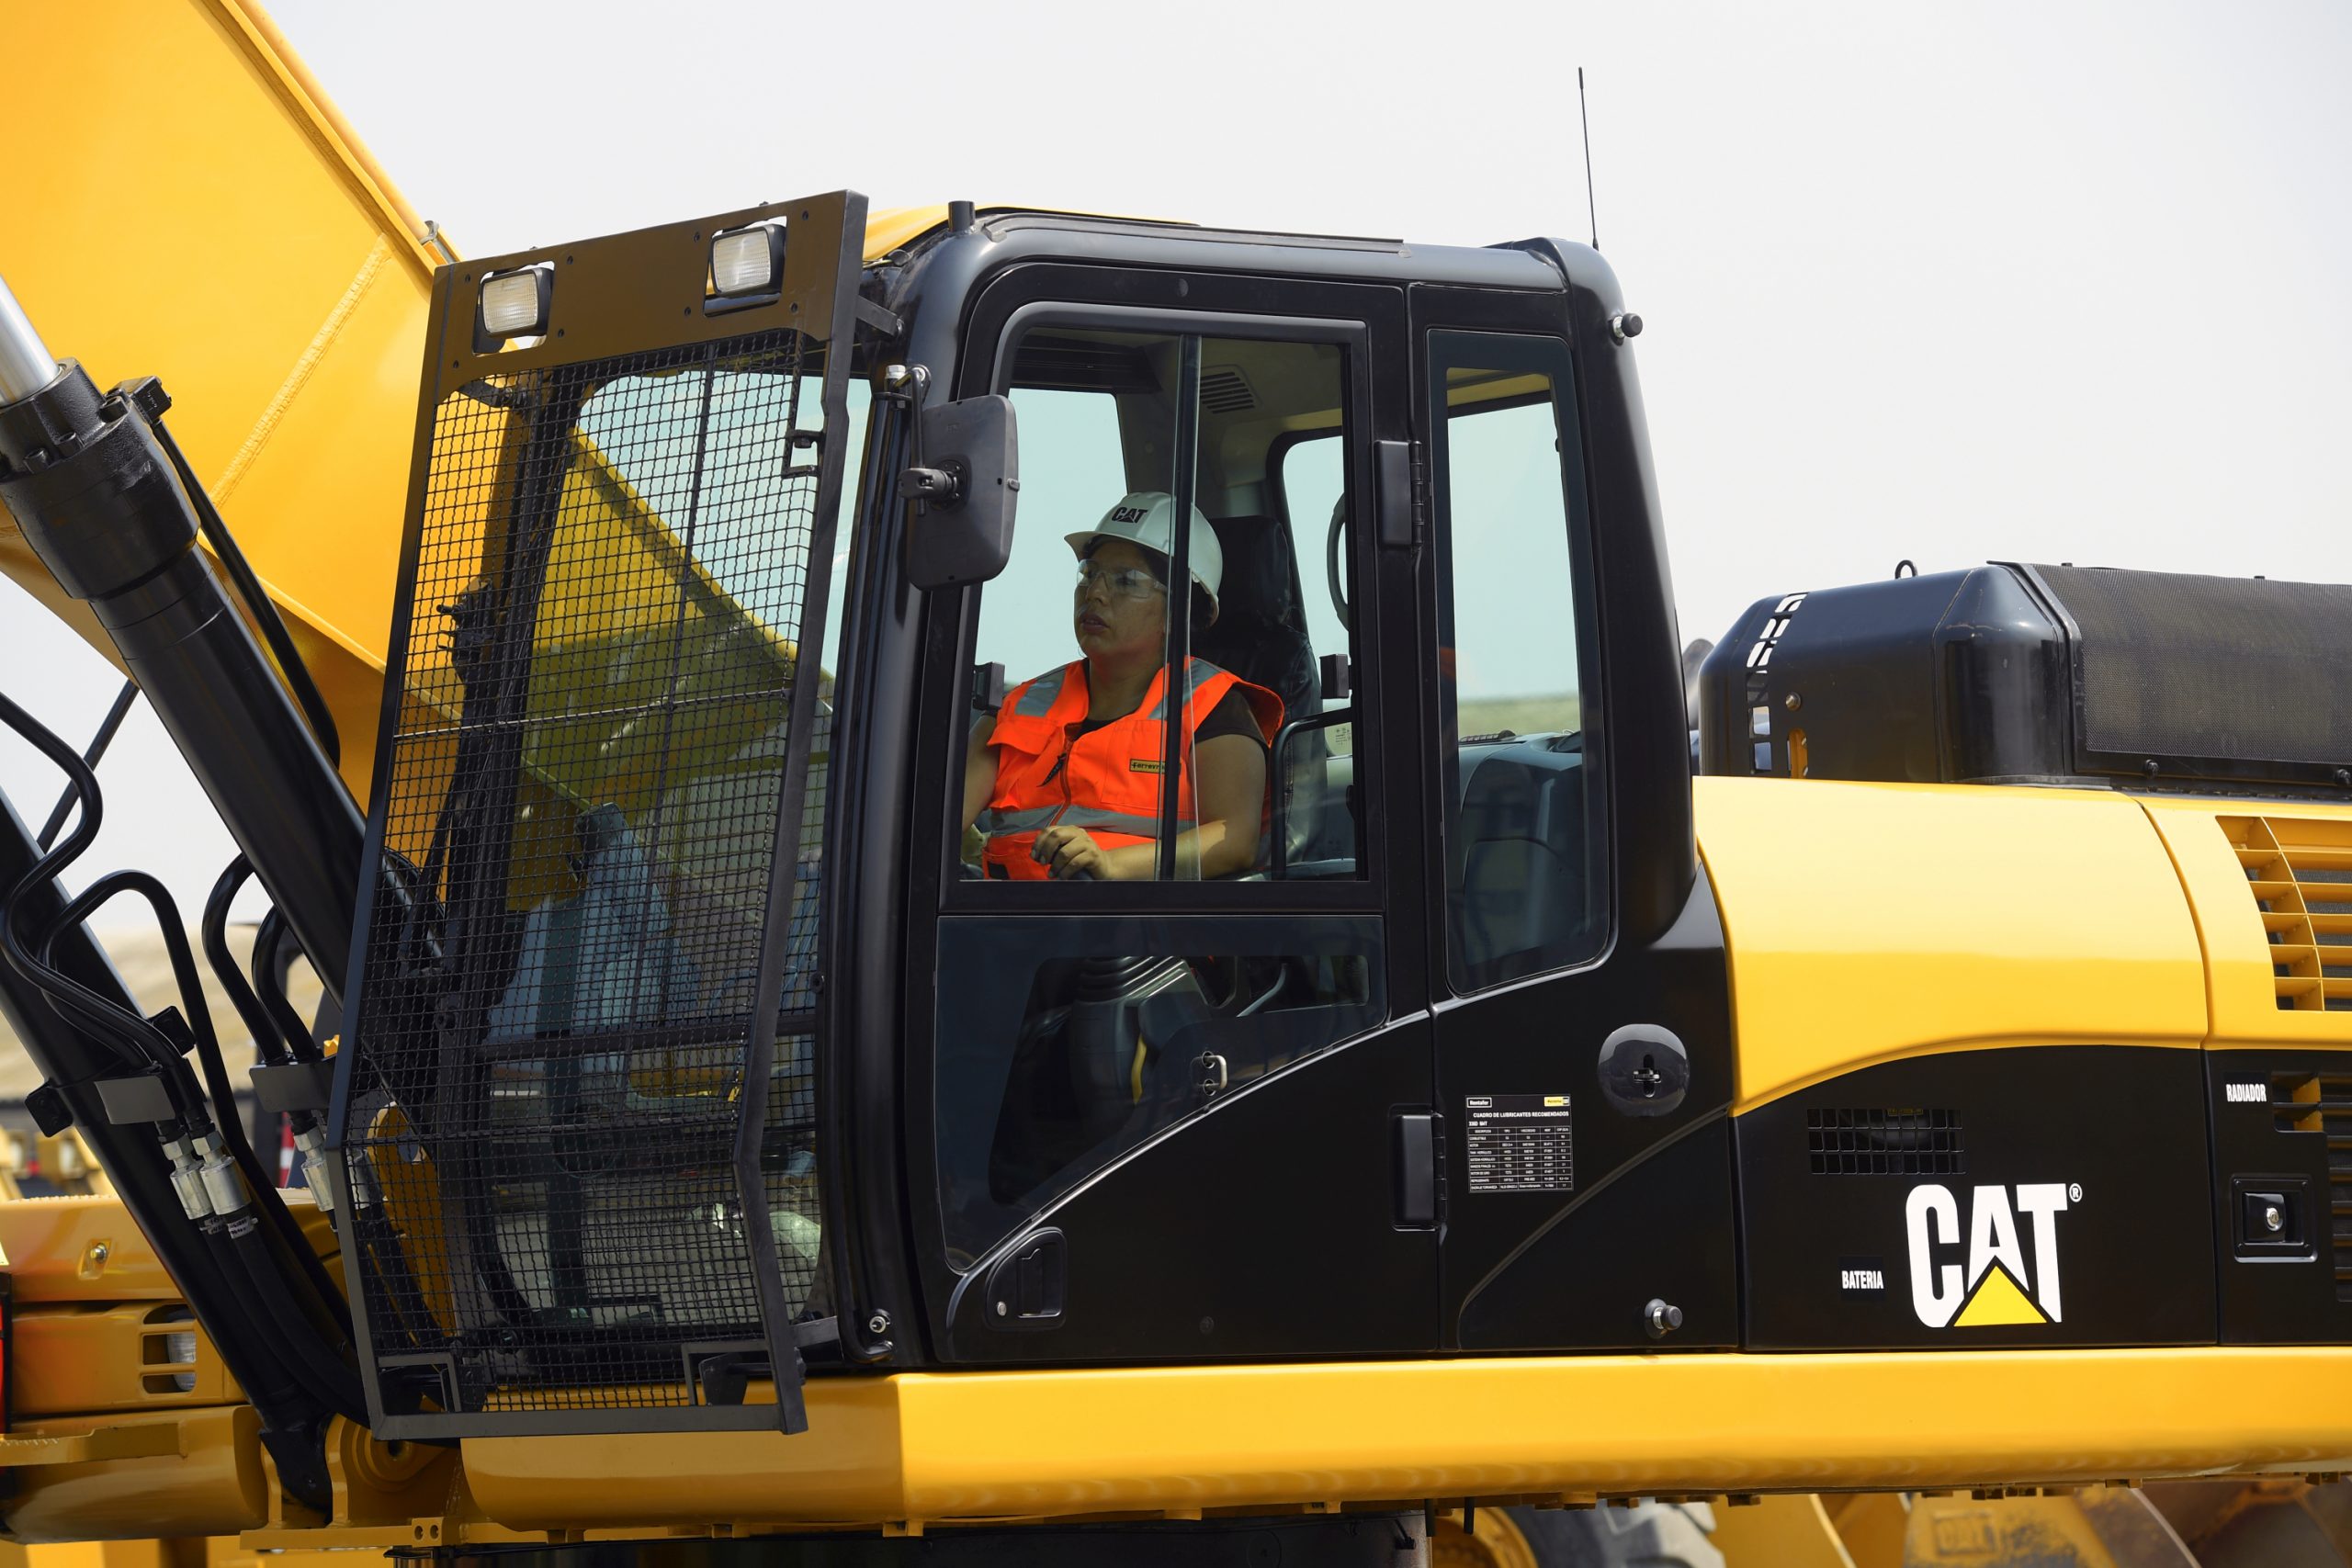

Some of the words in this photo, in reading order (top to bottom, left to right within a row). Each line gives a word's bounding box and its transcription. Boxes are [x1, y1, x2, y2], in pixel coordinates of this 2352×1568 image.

[1112, 507, 1148, 524] CAT
[2225, 1083, 2267, 1102] RADIADOR
[1842, 1269, 1884, 1290] BATERIA
